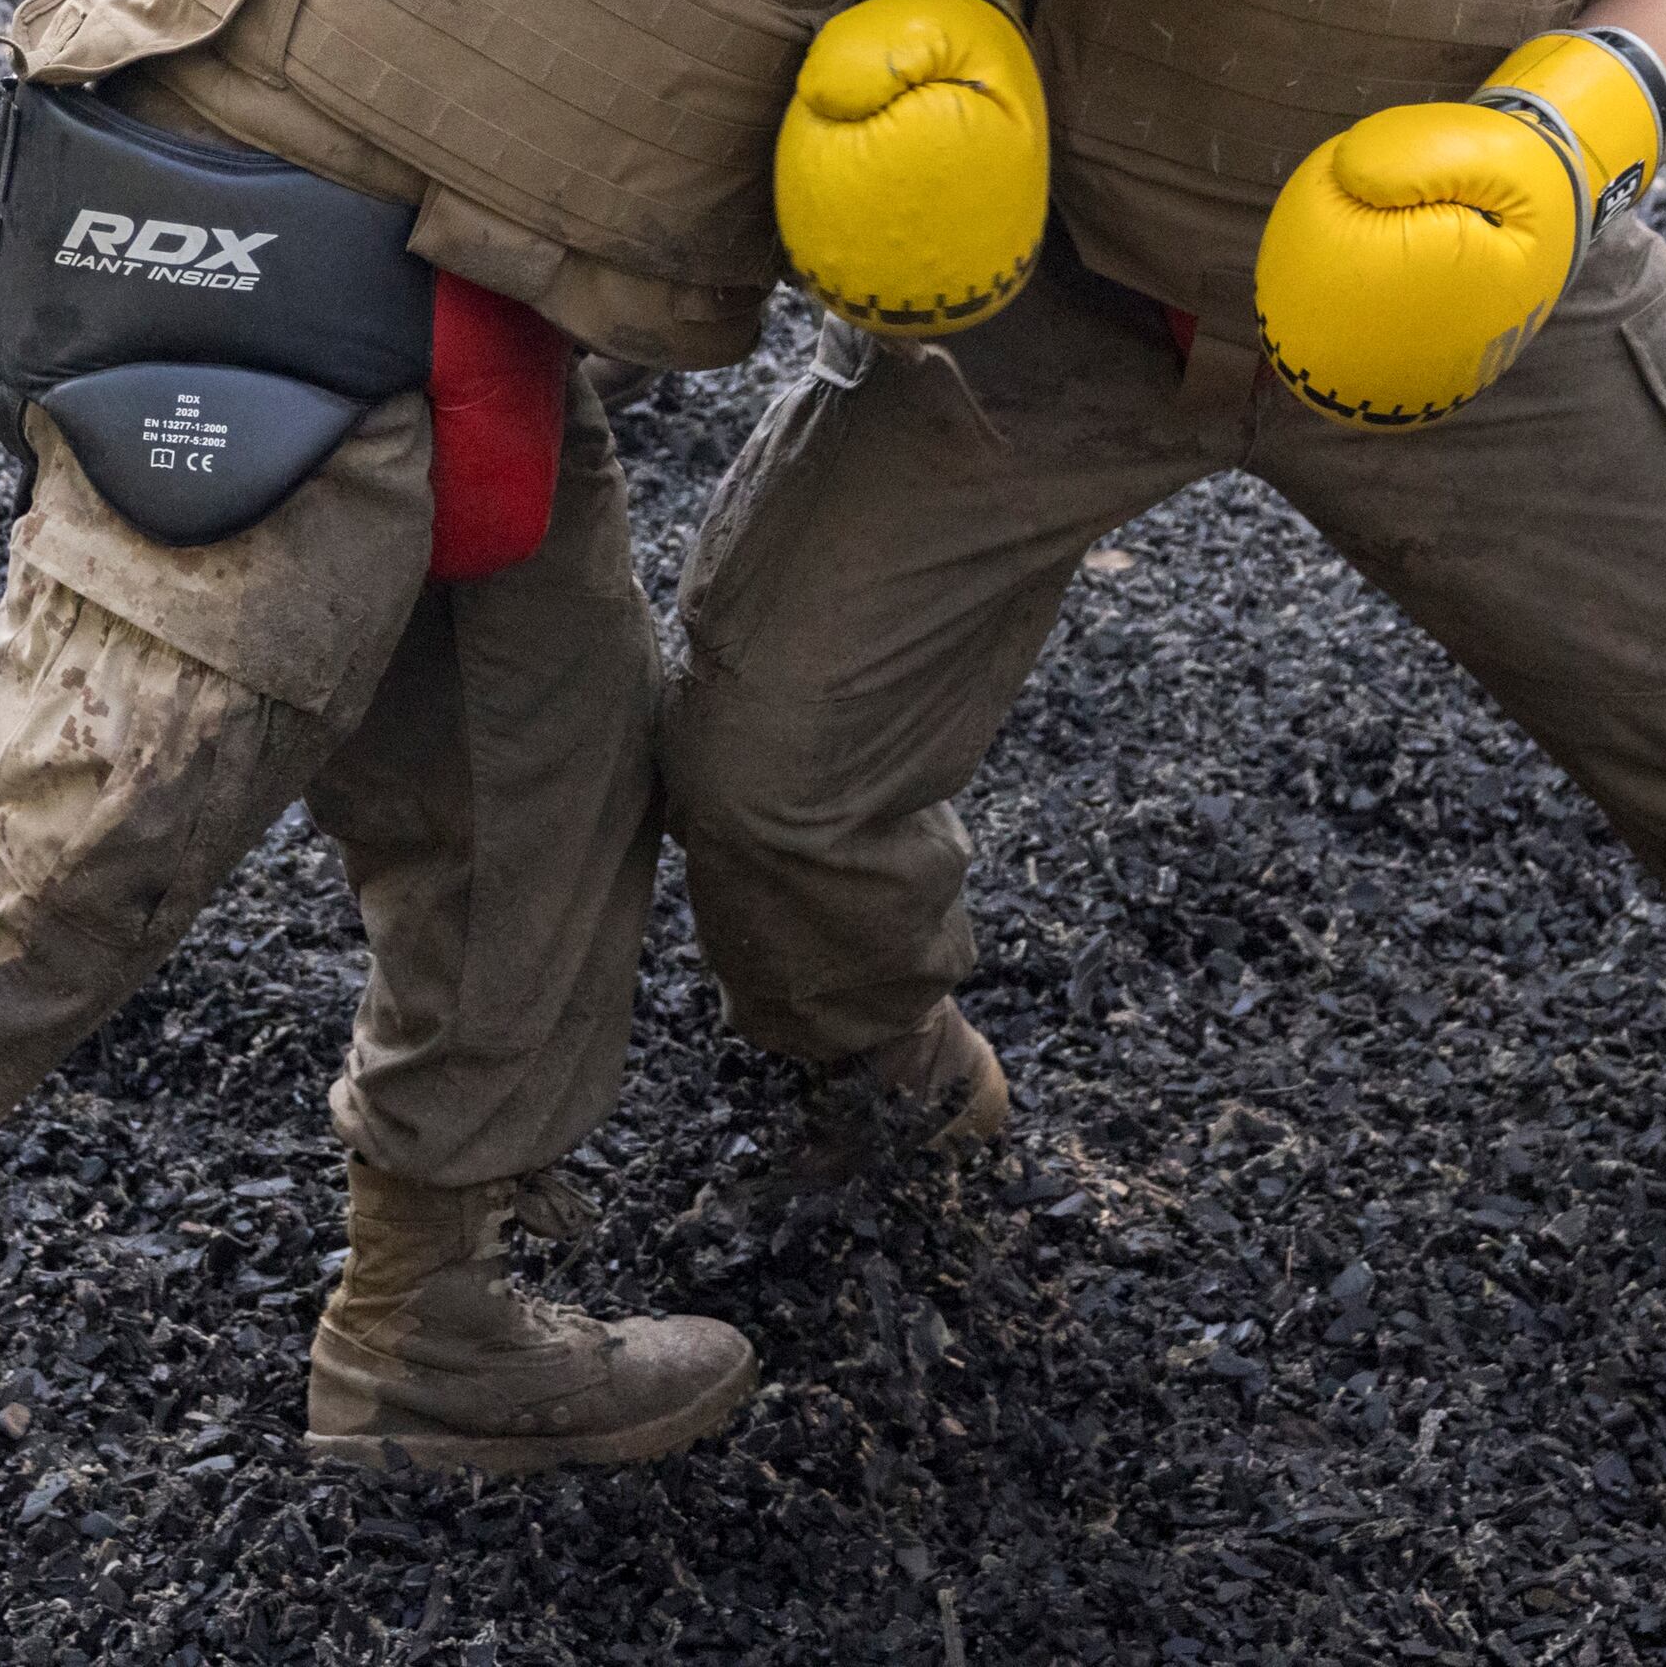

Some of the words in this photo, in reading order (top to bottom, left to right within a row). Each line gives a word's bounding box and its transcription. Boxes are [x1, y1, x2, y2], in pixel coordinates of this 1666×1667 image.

[62, 208, 279, 274] RDX
[54, 250, 142, 276] GIANT
[148, 266, 260, 291] INSIDE
[177, 394, 201, 405] RDX
[175, 407, 200, 418] 2020
[144, 418, 159, 428] EN
[162, 419, 228, 434] 13277-1:2000
[142, 431, 158, 441] EN
[161, 433, 226, 448] 13277-5:2002
